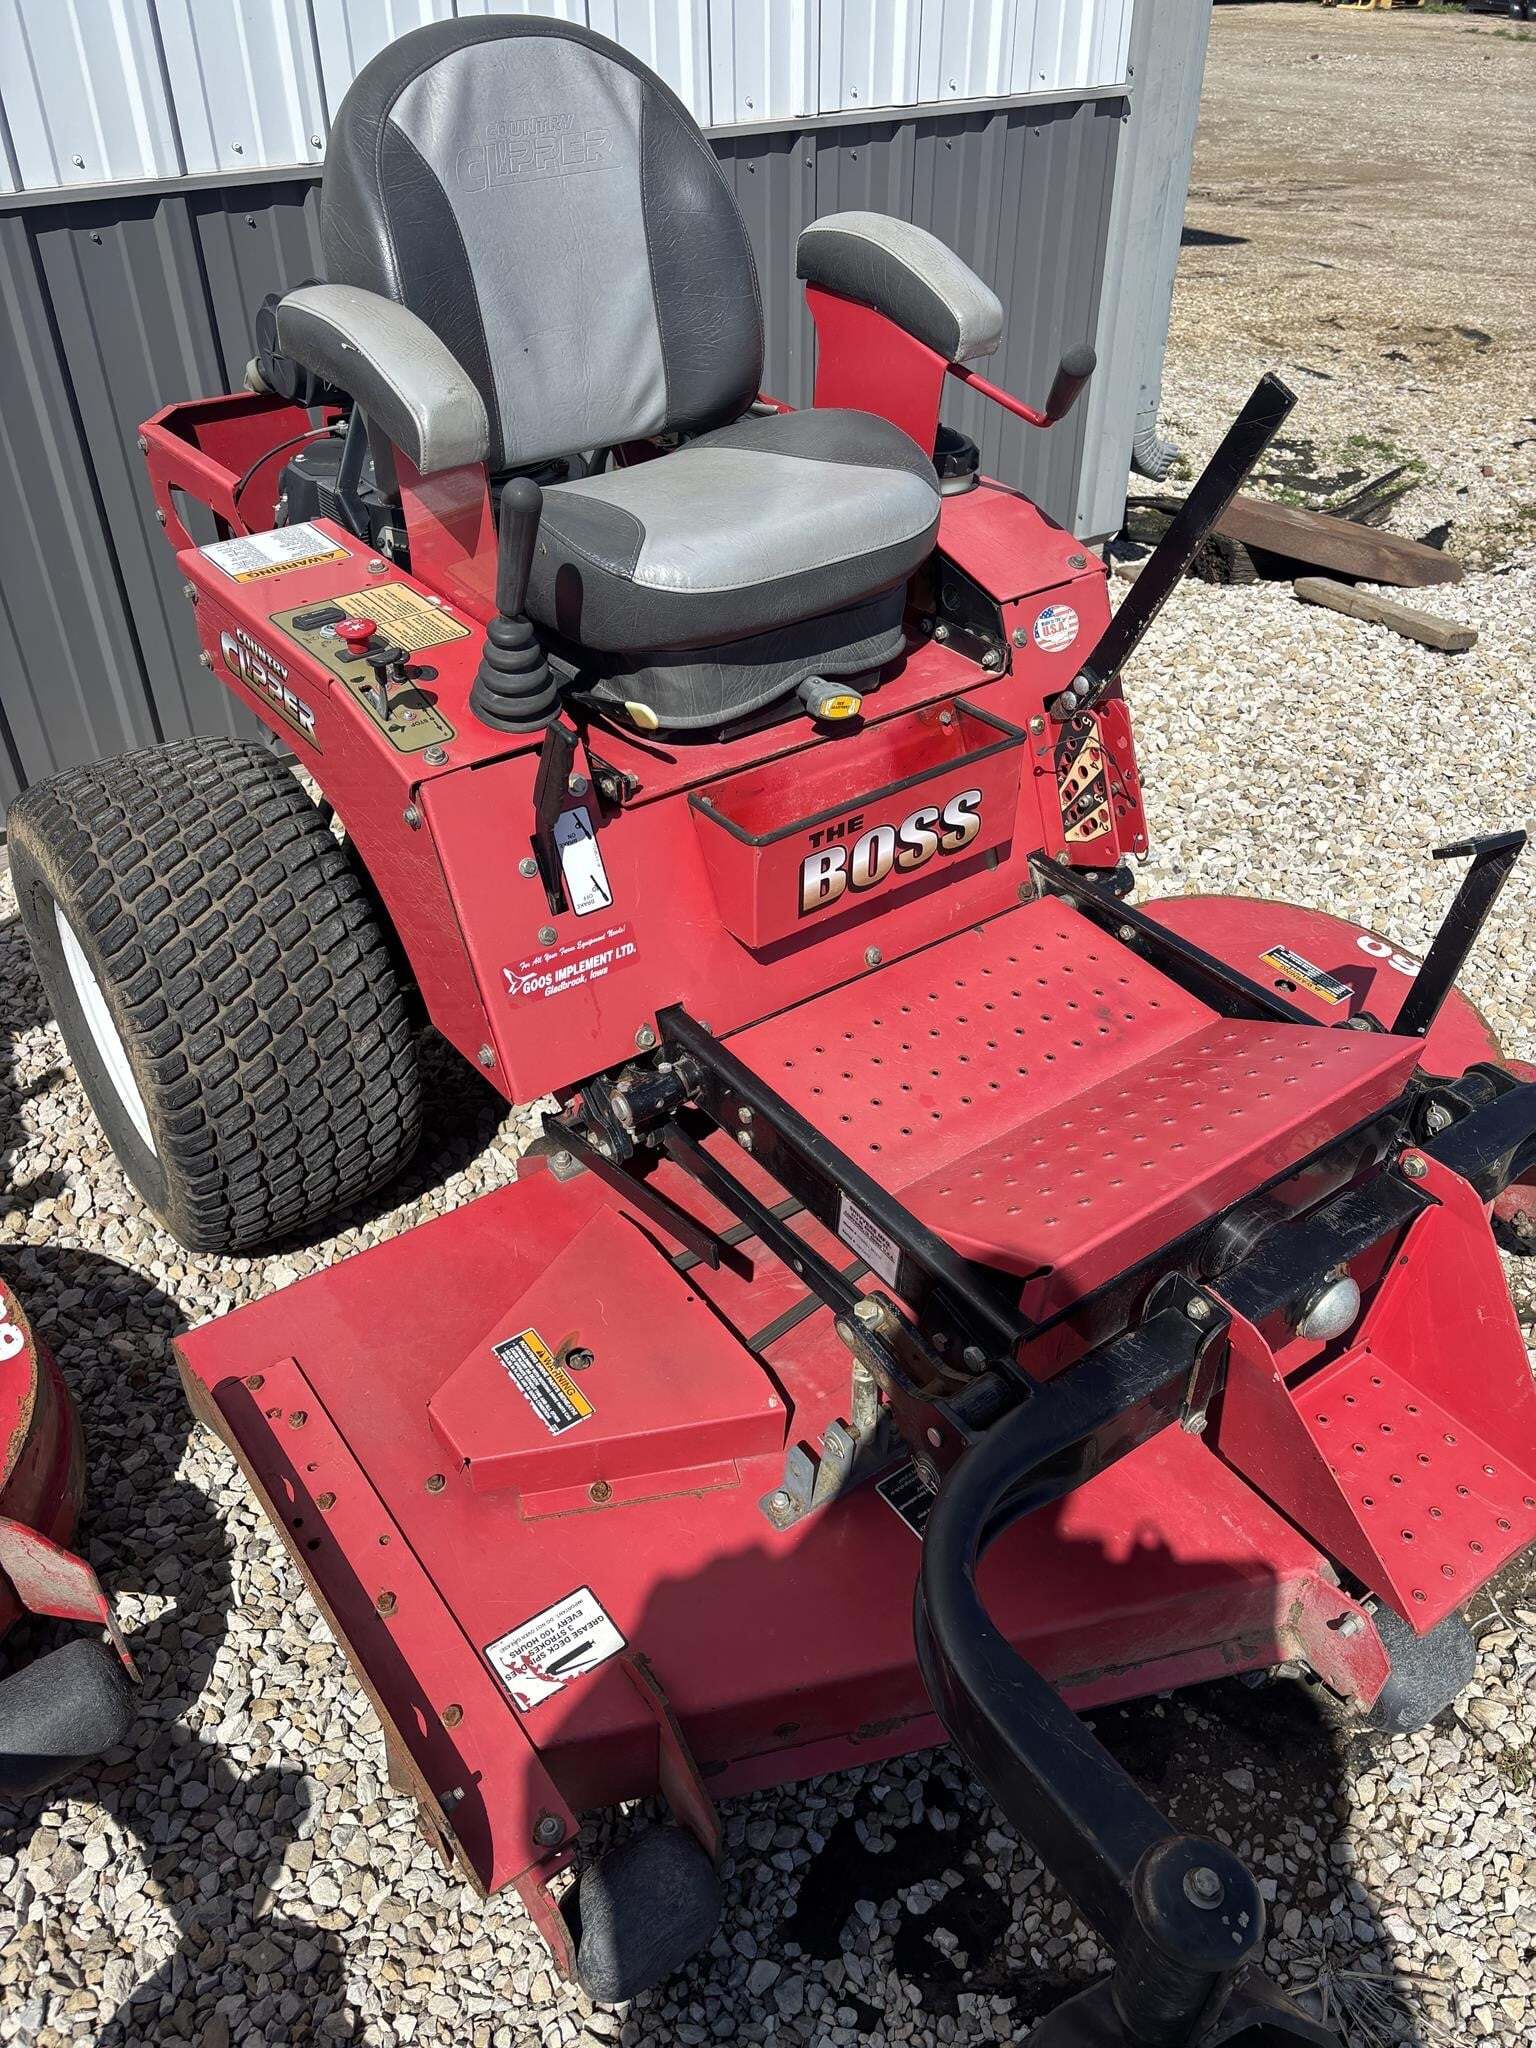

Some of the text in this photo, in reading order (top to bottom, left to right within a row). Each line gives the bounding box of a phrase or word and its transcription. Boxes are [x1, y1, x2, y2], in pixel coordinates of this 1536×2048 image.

[486, 112, 574, 138] COUNTRY
[456, 129, 614, 193] CLIPPER
[246, 556, 322, 578] WARNING
[236, 627, 289, 681] COUNTRY
[220, 630, 318, 747] CLIPPER
[1082, 716, 1092, 727] 5
[1090, 761, 1099, 770] 4
[1094, 793, 1104, 803] 3
[808, 813, 865, 849] THE
[1099, 821, 1109, 831] 2
[798, 788, 983, 919] BOSS
[522, 942, 637, 995] GOOS IMPLEMENT LTD.
[590, 967, 609, 979] Iowa
[542, 1356, 576, 1396] WARNING
[508, 1608, 583, 1659] EVERY 100 HOURS
[570, 1614, 604, 1639] GREASE
[527, 1628, 566, 1656] STROKES
[546, 1635, 571, 1654] DECK
